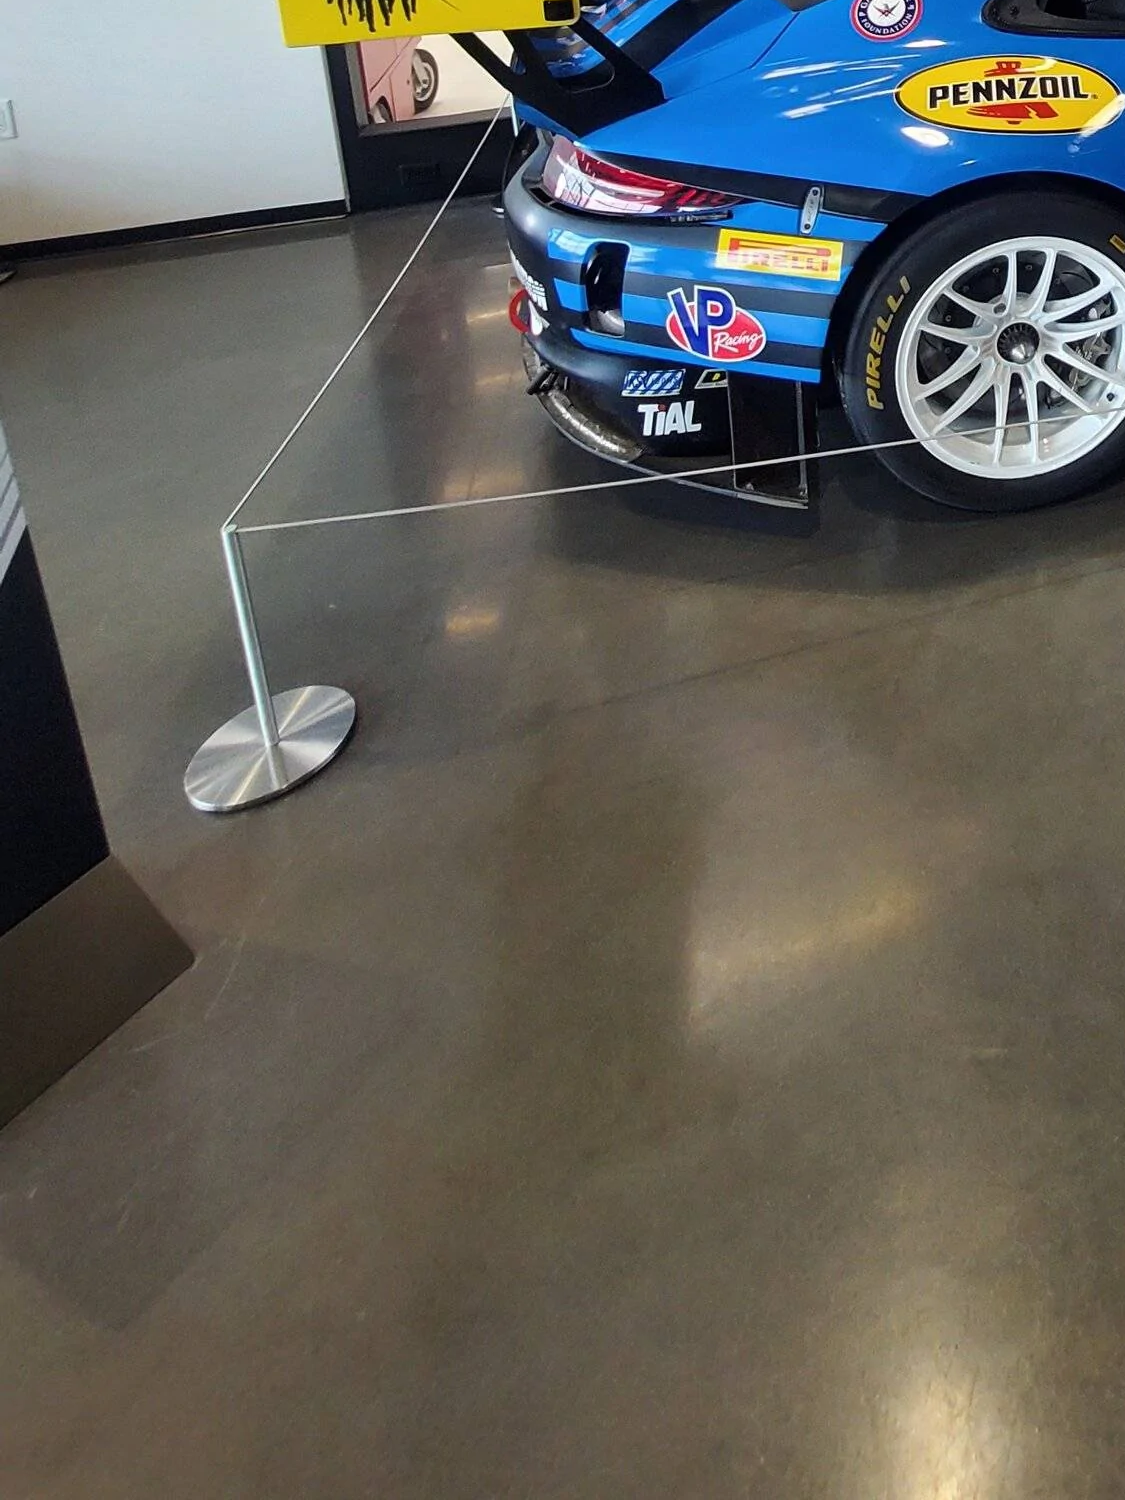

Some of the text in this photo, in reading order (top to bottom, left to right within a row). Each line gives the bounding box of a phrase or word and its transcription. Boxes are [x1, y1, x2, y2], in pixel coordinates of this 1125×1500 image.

[861, 13, 913, 34] FOUNDATION
[929, 76, 1089, 109] PENNZOIL
[667, 285, 736, 358] VP
[713, 331, 763, 353] Racing
[865, 275, 911, 410] PIRELLI
[637, 400, 702, 437] TiAL
